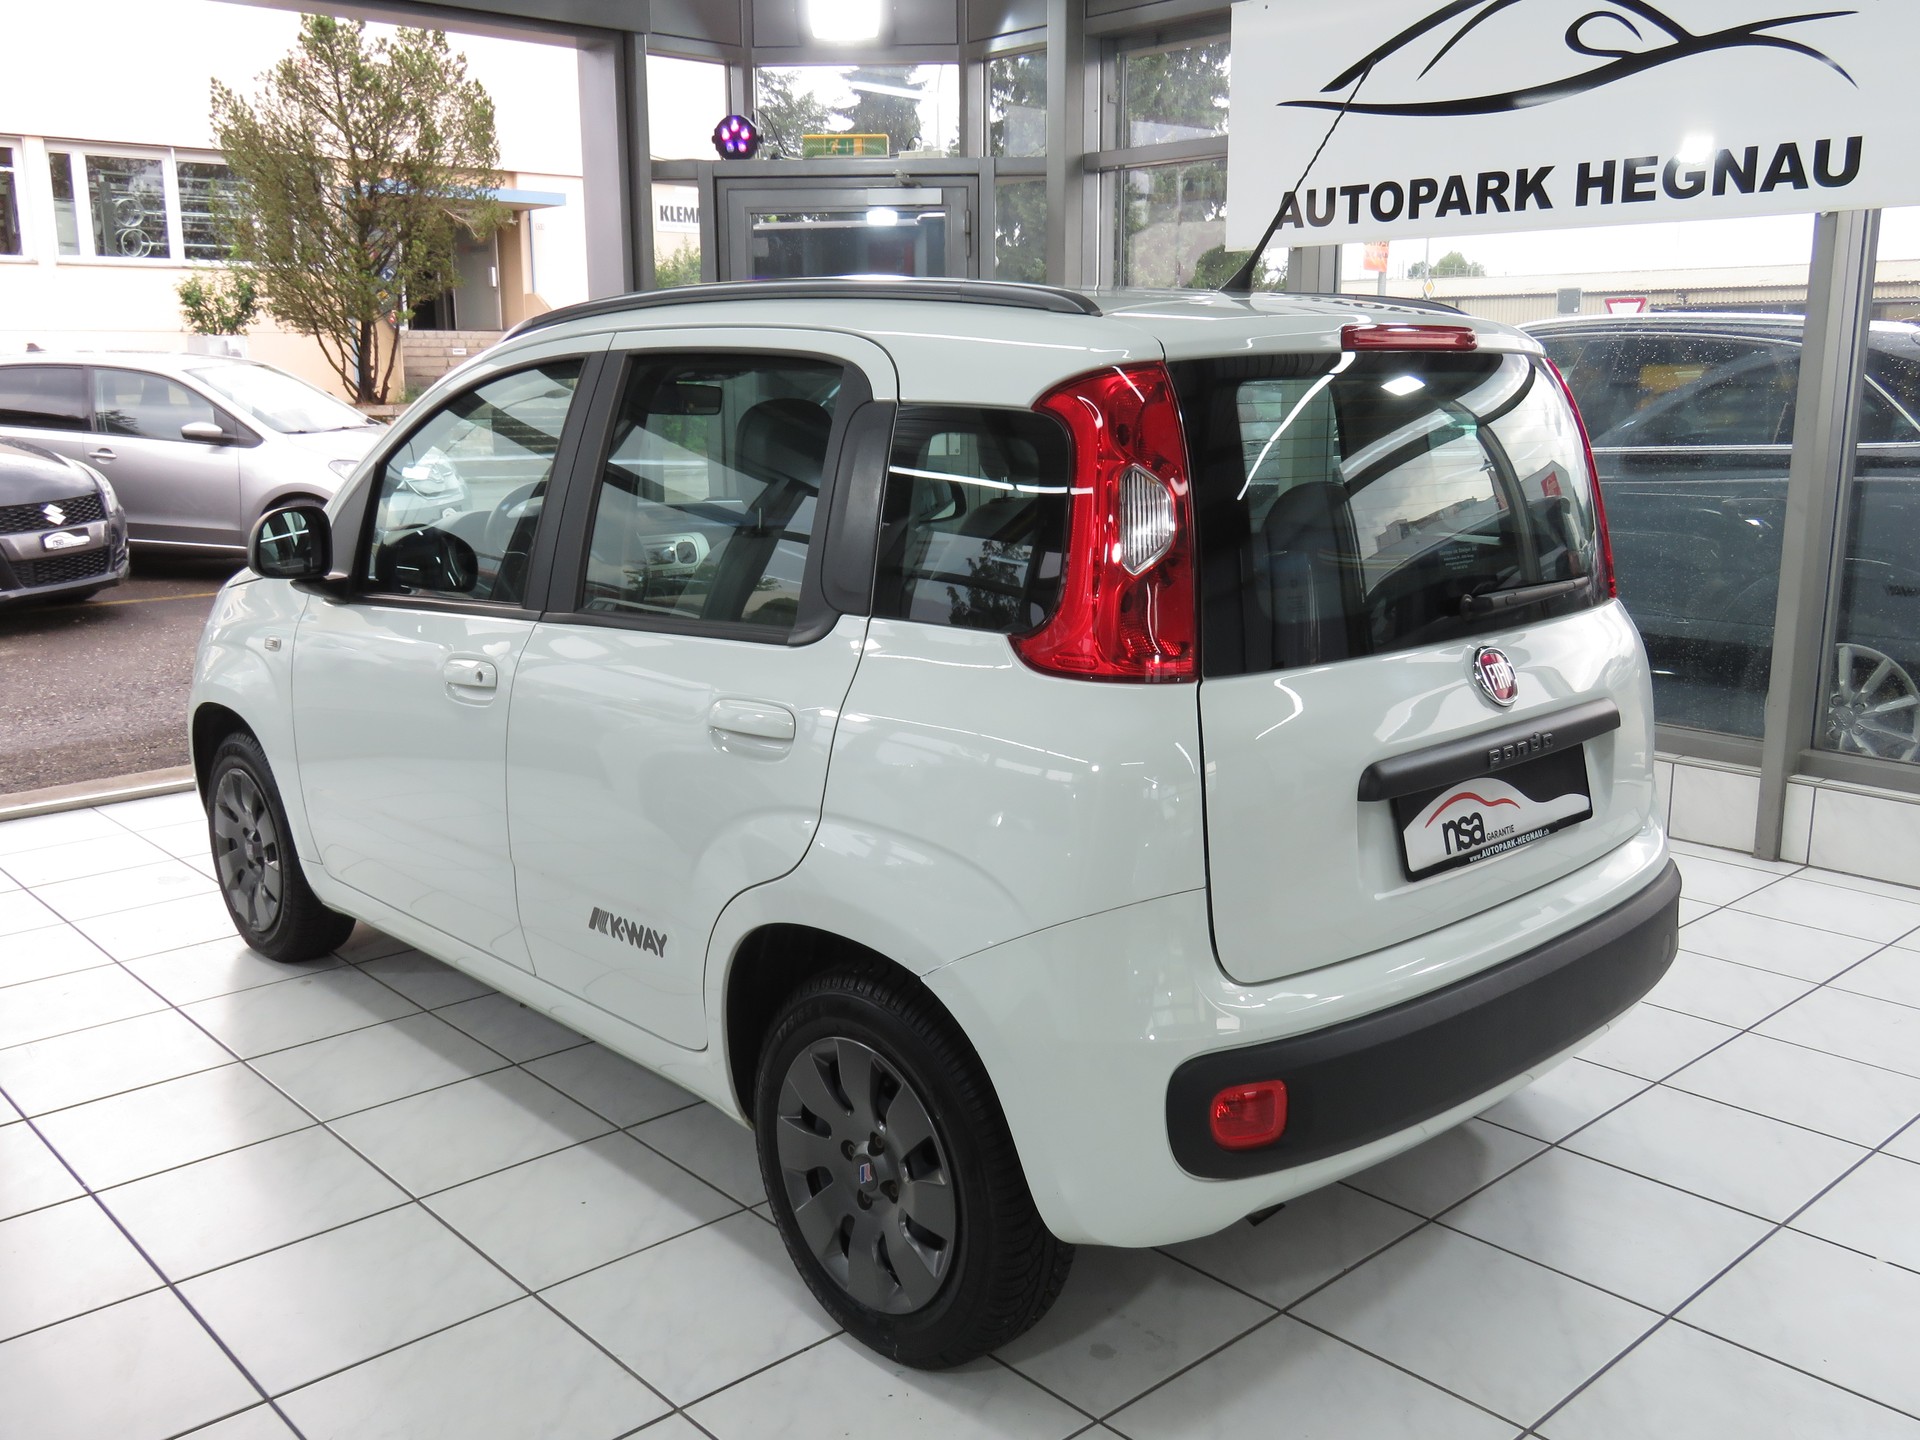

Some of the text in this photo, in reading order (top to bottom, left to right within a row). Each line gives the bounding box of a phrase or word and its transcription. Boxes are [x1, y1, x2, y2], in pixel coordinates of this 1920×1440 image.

[1276, 135, 1863, 230] AUTOPARK HEGNAU
[1485, 661, 1514, 691] FIAT
[1489, 731, 1553, 770] panda
[1441, 811, 1487, 855] nsa
[1486, 824, 1516, 841] GARANTIE
